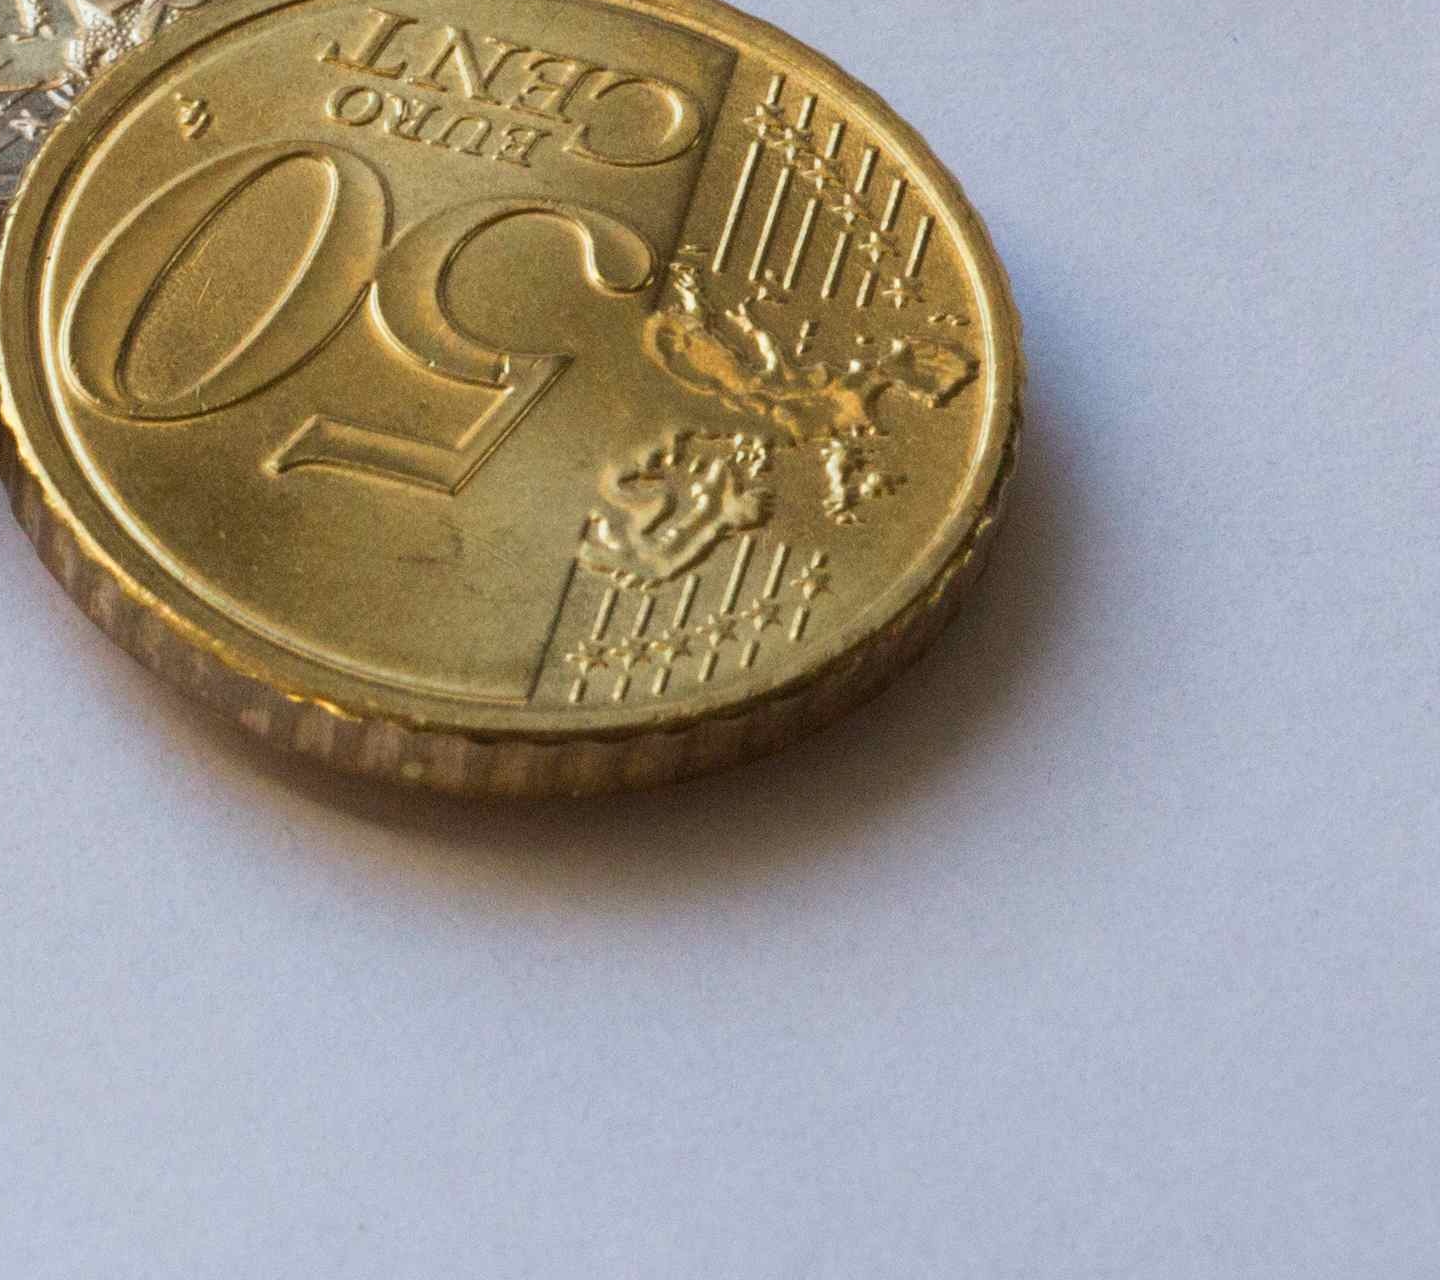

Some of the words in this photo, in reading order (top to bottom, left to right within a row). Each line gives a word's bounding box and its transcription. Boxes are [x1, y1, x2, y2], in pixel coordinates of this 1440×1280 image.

[316, 6, 708, 169] CENT
[324, 83, 556, 170] EURO
[58, 136, 658, 500] 50
